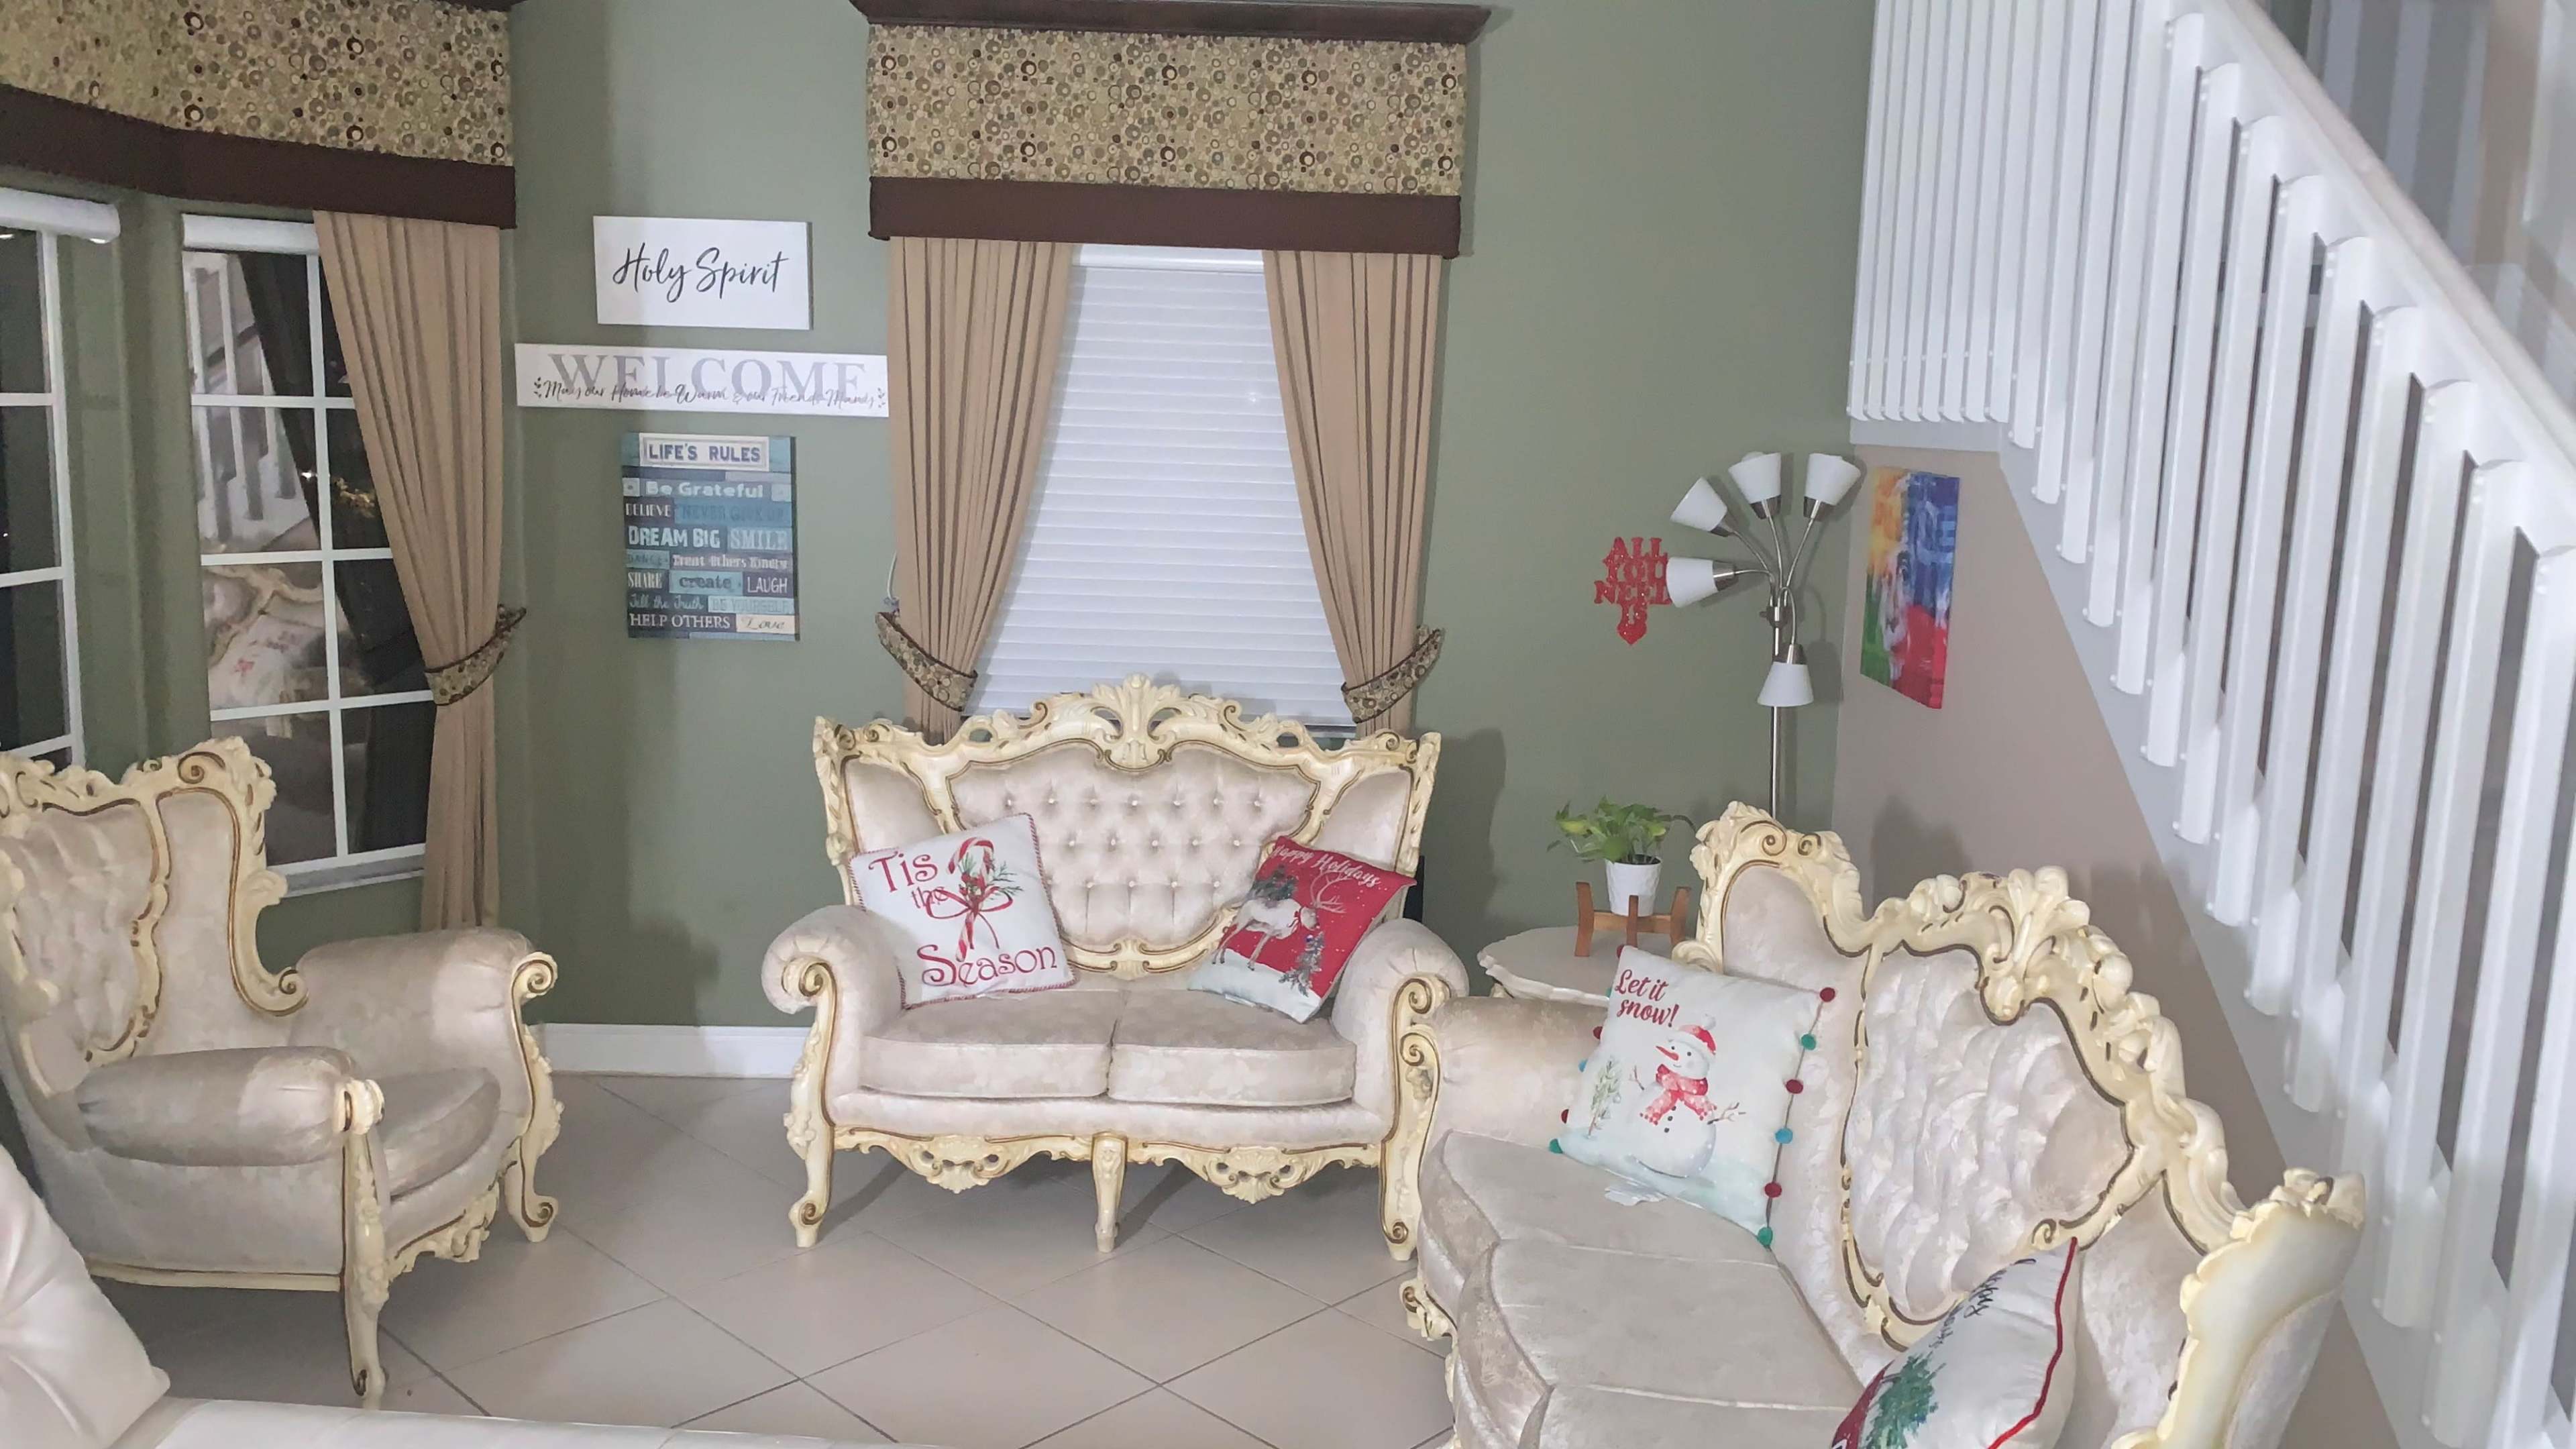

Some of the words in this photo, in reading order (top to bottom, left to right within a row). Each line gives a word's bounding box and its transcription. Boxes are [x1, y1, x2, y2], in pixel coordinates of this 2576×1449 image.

[612, 242, 691, 303] Holy
[696, 247, 789, 300] Spirit
[547, 353, 865, 401] WELCOME
[649, 443, 698, 461] LIFE'S
[708, 445, 761, 463] RULES
[645, 481, 673, 495] Be
[678, 482, 763, 498] Grateful
[625, 503, 671, 517] BELIEVE
[629, 525, 688, 547] DREAM
[693, 527, 720, 548] BIG
[729, 529, 788, 551] SMILE
[628, 572, 663, 588] SHARE
[747, 576, 788, 593] LAUGH
[653, 595, 669, 609] the
[629, 613, 667, 627] HELP
[672, 614, 731, 629] OTHERS
[868, 851, 938, 892] Tis
[1311, 854, 1381, 888] Holidays
[911, 885, 949, 909] the
[917, 944, 1057, 987] Season
[1615, 969, 1651, 997] Let
[1649, 979, 1668, 1002] it
[1617, 999, 1680, 1028] snow!
